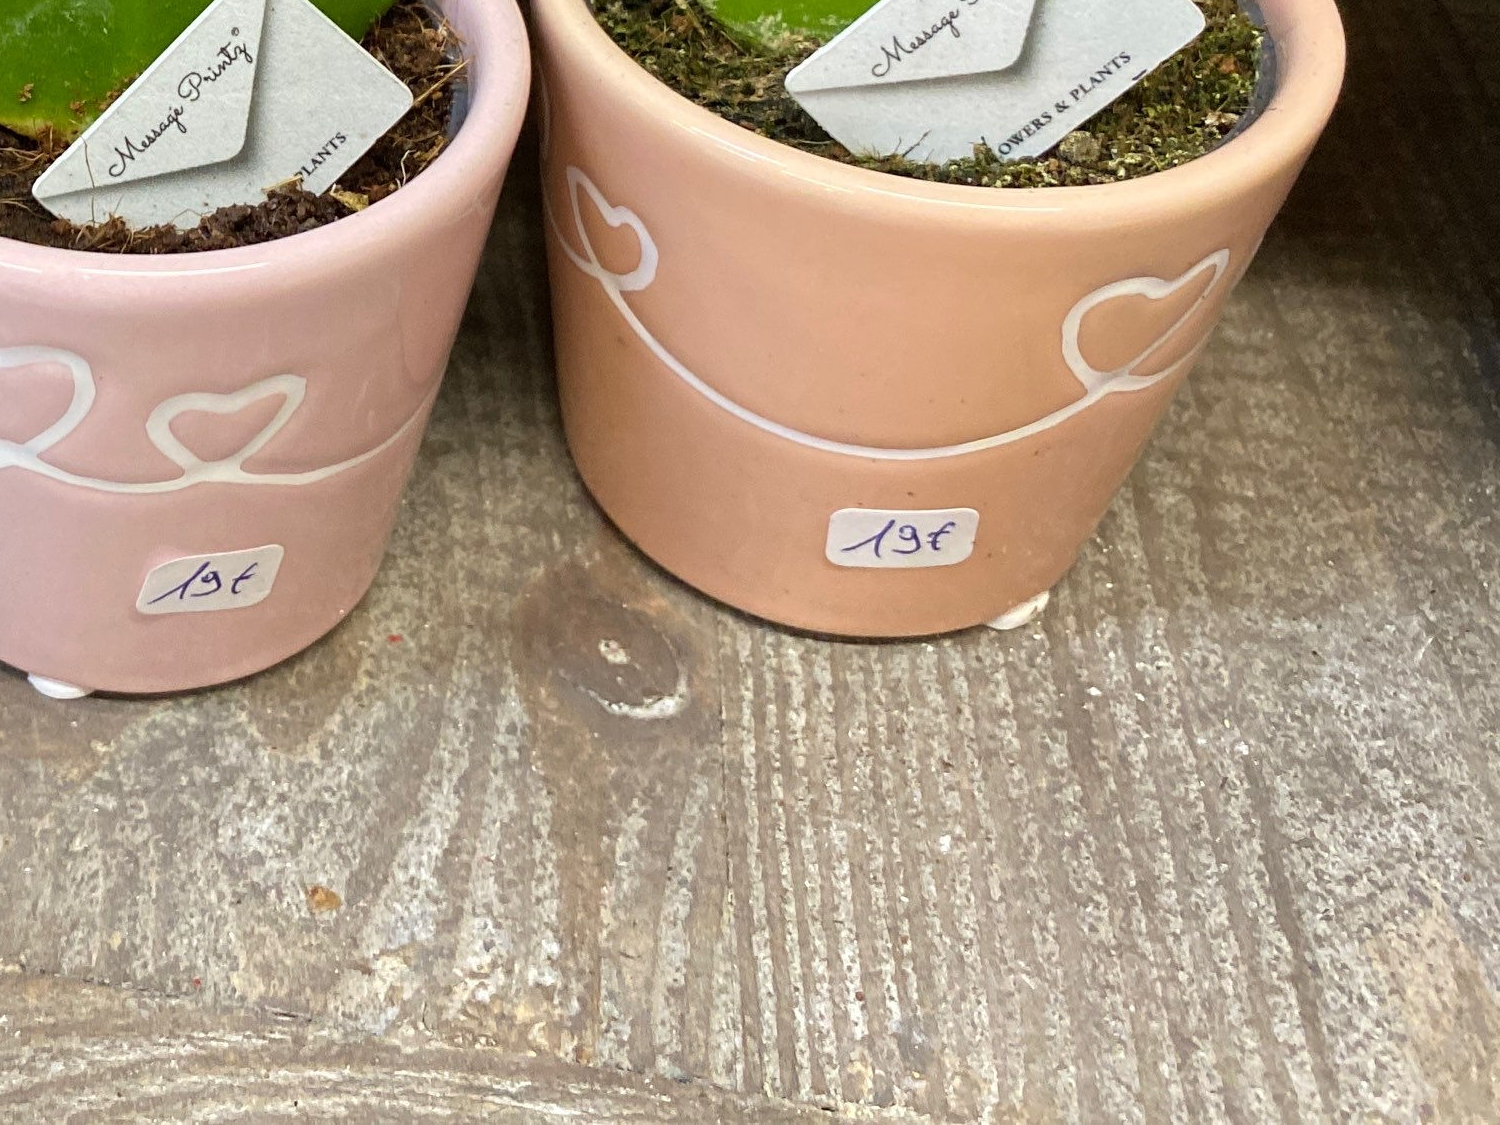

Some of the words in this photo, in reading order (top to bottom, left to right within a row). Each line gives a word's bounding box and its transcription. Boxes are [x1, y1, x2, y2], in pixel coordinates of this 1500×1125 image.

[871, 8, 961, 78] Message
[997, 111, 1052, 156] OWERS
[1054, 99, 1070, 113] &
[1070, 51, 1132, 103] PLANTS
[108, 105, 187, 177] Message
[840, 518, 957, 559] 19€
